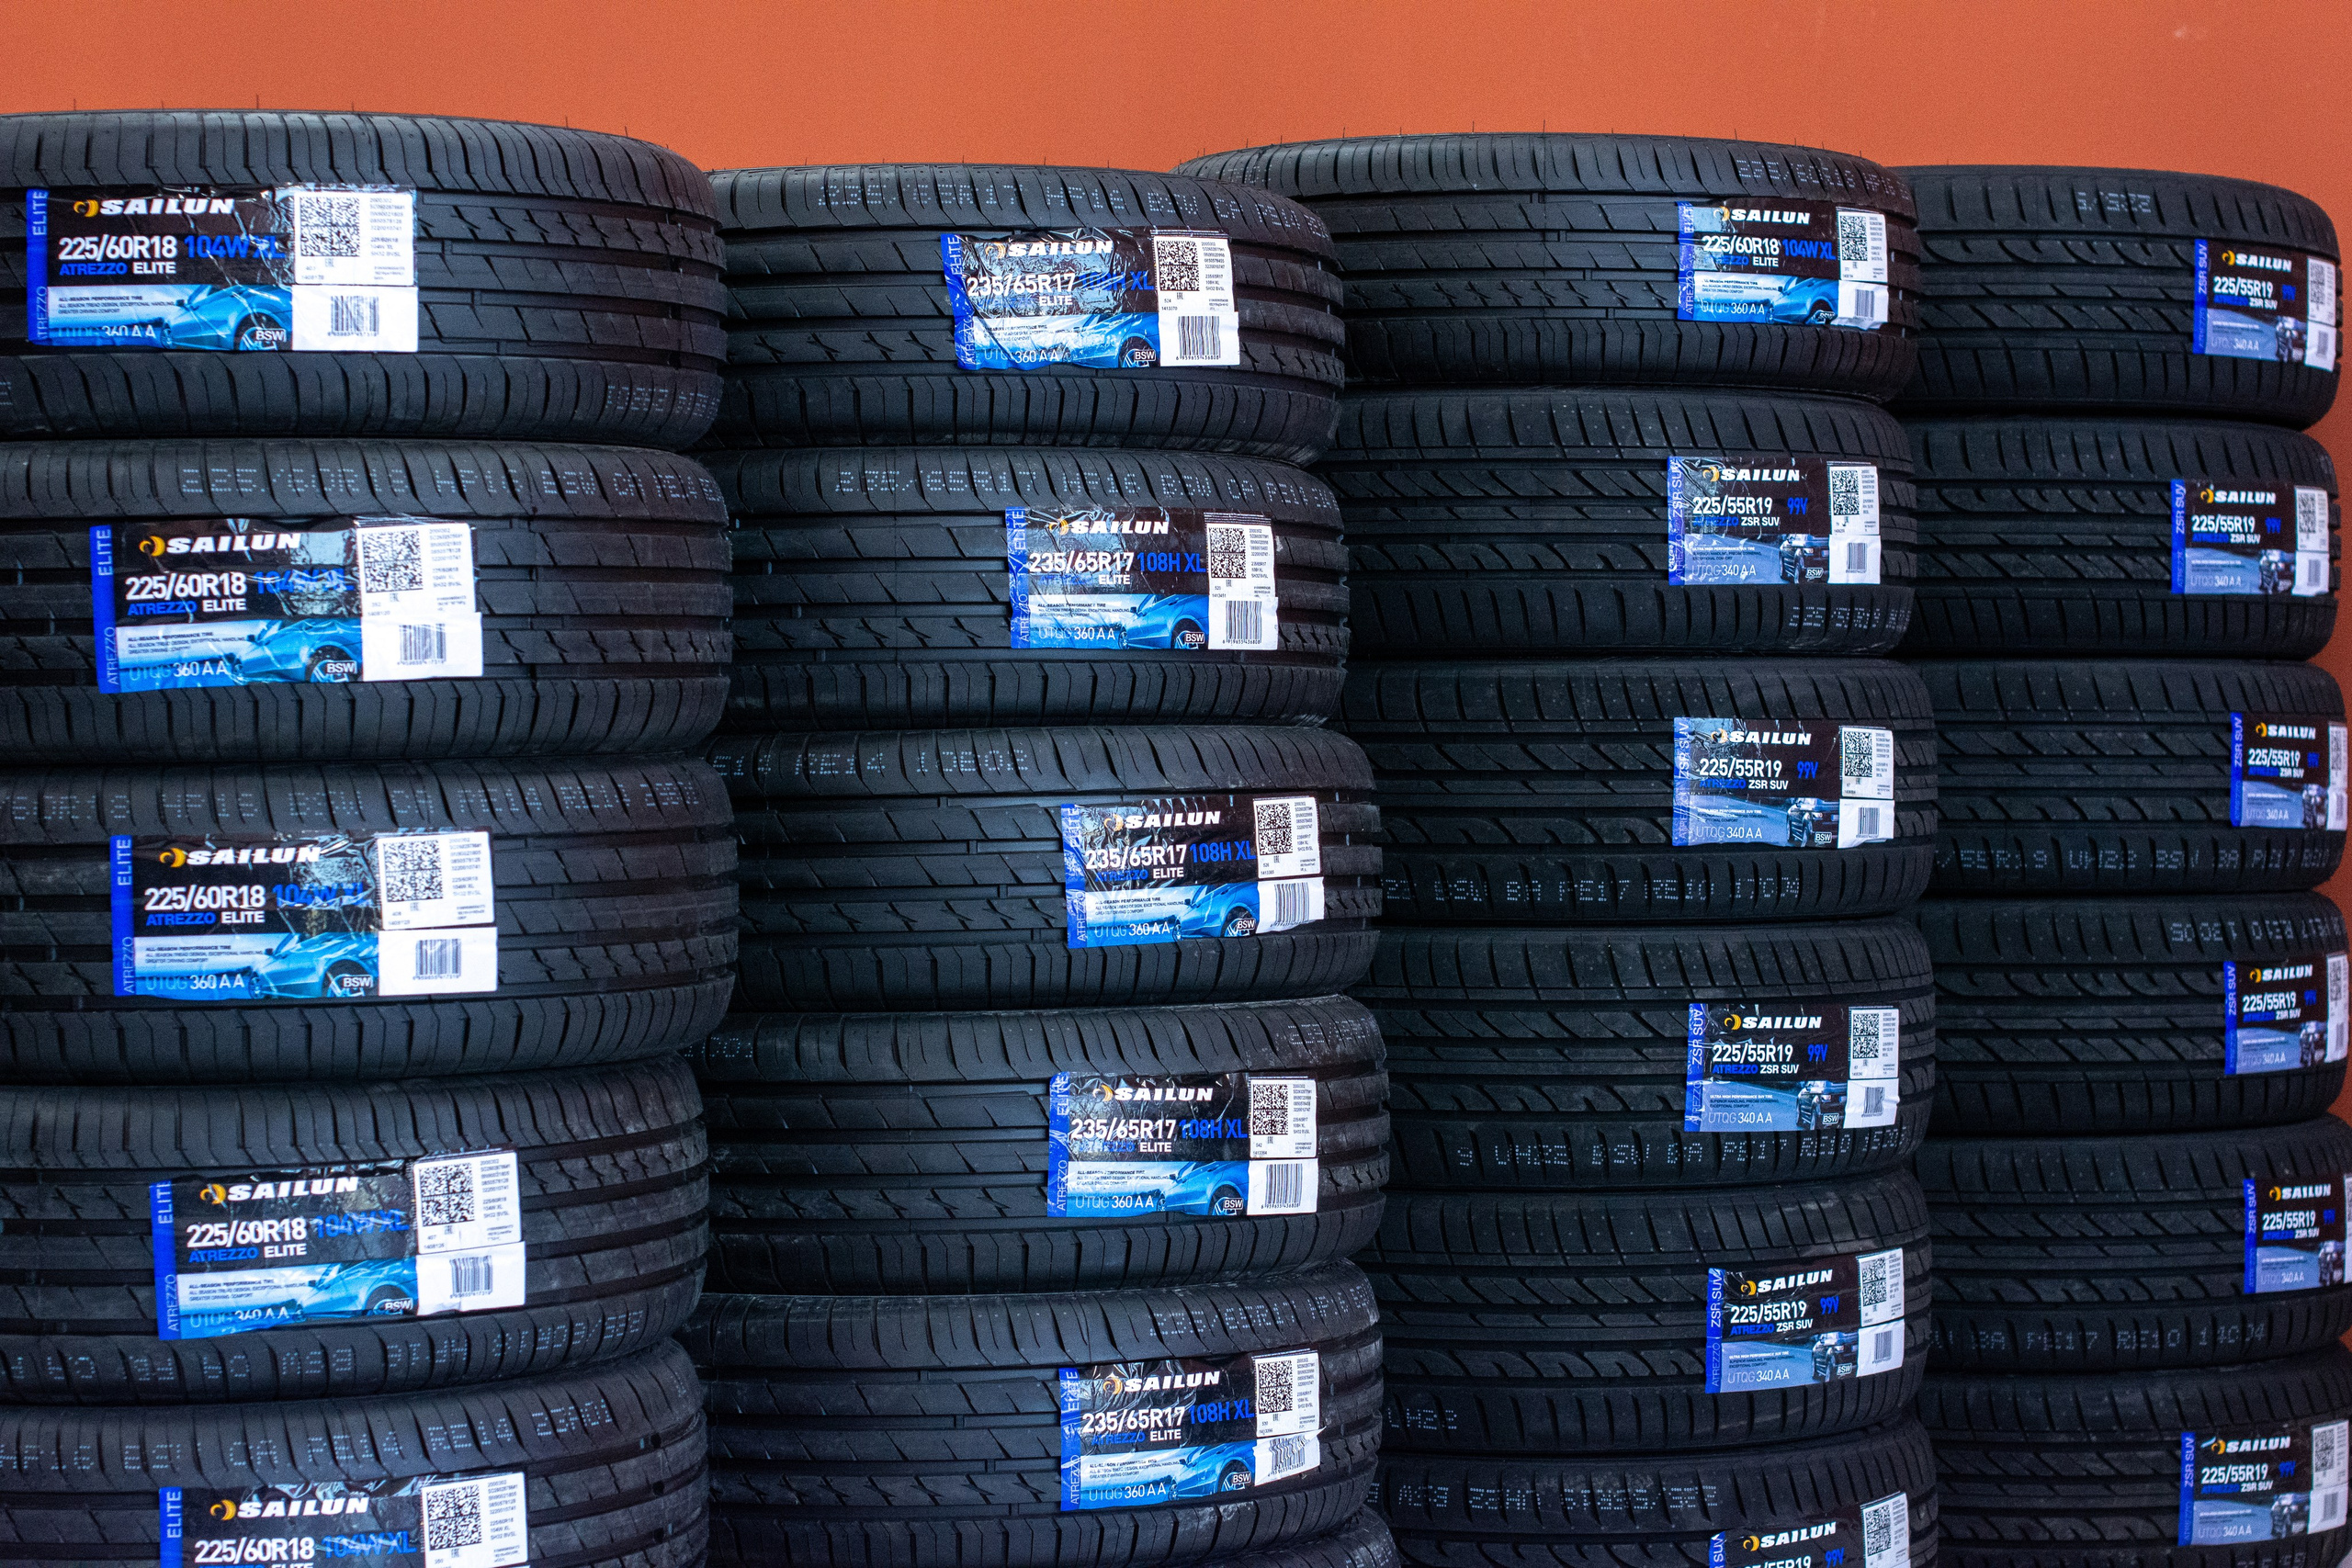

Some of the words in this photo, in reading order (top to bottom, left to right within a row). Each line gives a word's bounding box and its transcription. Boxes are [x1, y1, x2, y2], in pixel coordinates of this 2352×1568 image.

[100, 198, 234, 215] SAILUN
[1731, 209, 1810, 225] SAILUN
[59, 234, 177, 261] 225/60R18
[184, 235, 249, 258] 104W
[1008, 241, 1112, 256] SAILUN
[1702, 235, 1780, 255] 225/60R18
[1782, 238, 1818, 258] 104W
[1819, 241, 1837, 260] XL
[59, 263, 128, 276] ATREZZO
[133, 262, 176, 274] ELITE
[1752, 256, 1779, 267] ELITE
[2235, 254, 2292, 272] SAILUN
[967, 273, 1076, 297] 235/65R17
[1130, 271, 1153, 290] XL
[2213, 276, 2274, 299] 225/55R19
[1039, 295, 1073, 307] ELITE
[255, 330, 284, 341] BSW
[1135, 351, 1155, 360] BSW
[1721, 468, 1800, 481] SAILUN
[1692, 495, 1773, 515] 225/55R19
[1787, 497, 1808, 515] 99V
[2176, 484, 2186, 508] SUV
[2214, 491, 2276, 504] SAILUN
[1070, 521, 1170, 535] SAILUN
[1740, 516, 1761, 526] ZSR
[1761, 516, 1780, 526] SUV
[2176, 511, 2185, 534] ZSR
[2191, 514, 2256, 533] 225/55R19
[96, 528, 113, 576] ELITE
[166, 533, 300, 554] SAILUN
[1029, 551, 1135, 573] 235/65R17
[1136, 553, 1181, 573] 108H
[1183, 553, 1206, 573] XL
[126, 572, 247, 600] 225/60R18
[1099, 574, 1131, 585] ELITE
[128, 600, 198, 615] ATREZZO
[202, 599, 246, 612] ELITE
[1074, 626, 1094, 639] 360
[107, 626, 120, 684] ATREZZO
[1729, 730, 1812, 746] SAILUN
[2267, 724, 2316, 740] SAILUN
[2248, 747, 2301, 767] 225/55R19
[1700, 758, 1782, 778] 225/55R19
[1797, 761, 1818, 779] 99V
[1748, 780, 1768, 789] ZSR
[1770, 781, 1789, 790] SUV
[1125, 811, 1221, 829] SAILUN
[1726, 827, 1744, 838] 340
[117, 839, 132, 886] ELITE
[186, 847, 322, 865] SAILUN
[1085, 844, 1187, 870] 235/65R17
[1189, 842, 1232, 863] 108H
[1235, 840, 1256, 861] XL
[1153, 867, 1184, 879] ELITE
[144, 885, 266, 911] 225/60R18
[146, 912, 216, 926] ATREZZO
[220, 911, 265, 924] ELITE
[1128, 923, 1150, 936] 360
[122, 936, 136, 994] ATREZZO
[2262, 964, 2313, 981] SAILUN
[190, 975, 216, 989] 360
[220, 975, 231, 988] A
[232, 974, 245, 987] A
[344, 976, 370, 987] BSW
[2228, 966, 2236, 989] SUV
[2228, 992, 2236, 1015] ZSR
[2243, 991, 2297, 1012] 225/55R19
[1693, 1009, 1703, 1035] SUV
[1742, 1017, 1822, 1029] SAILUN
[1692, 1039, 1702, 1066] ZSR
[1713, 1043, 1793, 1063] 225/55R19
[1807, 1043, 1828, 1062] 99V
[1712, 1065, 1758, 1074] ATREZZO
[1760, 1064, 1780, 1074] ZSR
[1781, 1064, 1799, 1074] SUV
[1114, 1089, 1214, 1101] SAILUN
[1708, 1112, 1736, 1123] UTQG
[1737, 1111, 1756, 1122] 340
[1757, 1111, 1764, 1122] A
[1765, 1111, 1772, 1122] A
[1824, 1114, 1838, 1123] BSW
[1070, 1118, 1176, 1140] 235/65R17
[1179, 1119, 1222, 1139] 108H
[1226, 1119, 1248, 1139] XL
[1139, 1142, 1172, 1153] ELITE
[227, 1177, 359, 1201] SAILUN
[2281, 1184, 2332, 1200] SAILUN
[1075, 1196, 1110, 1209] UTQG
[1112, 1196, 1133, 1208] 360
[1135, 1195, 1144, 1208] A
[1145, 1195, 1154, 1208] A
[1224, 1199, 1243, 1209] BSW
[2262, 1211, 2316, 1231] 225/55R19
[187, 1217, 307, 1247] 225/60R18
[188, 1247, 258, 1263] ATREZZO
[264, 1243, 307, 1258] ELITE
[1712, 1271, 1723, 1301] SUV
[1758, 1269, 1833, 1293] SAILUN
[165, 1274, 180, 1332] ATREZZO
[1730, 1301, 1807, 1324] 225/55R19
[1820, 1296, 1839, 1315] 99V
[1711, 1302, 1722, 1328] ZSR
[1730, 1324, 1774, 1336] ATREZZO
[1776, 1321, 1794, 1332] ZSR
[1796, 1319, 1813, 1330] SUV
[1711, 1342, 1721, 1387] ATREZZO
[1124, 1371, 1221, 1393] SAILUN
[1756, 1370, 1774, 1382] 340
[1082, 1406, 1185, 1433] 235/65R17
[1188, 1403, 1231, 1425] 108H
[1233, 1399, 1255, 1419] XL
[1150, 1428, 1182, 1442] ELITE
[2185, 1438, 2194, 1461] SUV
[2226, 1437, 2291, 1453] SAILUN
[1232, 1472, 1251, 1483] BSW
[2185, 1464, 2194, 1488] ZSR
[2201, 1463, 2268, 1484] 225/55R19
[1089, 1487, 1122, 1502] UTQG
[1124, 1484, 1145, 1498] 360
[2240, 1482, 2257, 1493] ZSR
[2257, 1481, 2273, 1491] SUV
[166, 1491, 182, 1539] ELITE
[238, 1497, 369, 1517] SAILUN
[1760, 1522, 1837, 1549] SAILUN
[195, 1537, 315, 1563] 225/60R18
[322, 1531, 385, 1558] 104W
[387, 1531, 416, 1554] XL
[1825, 1547, 1845, 1567] 99V
